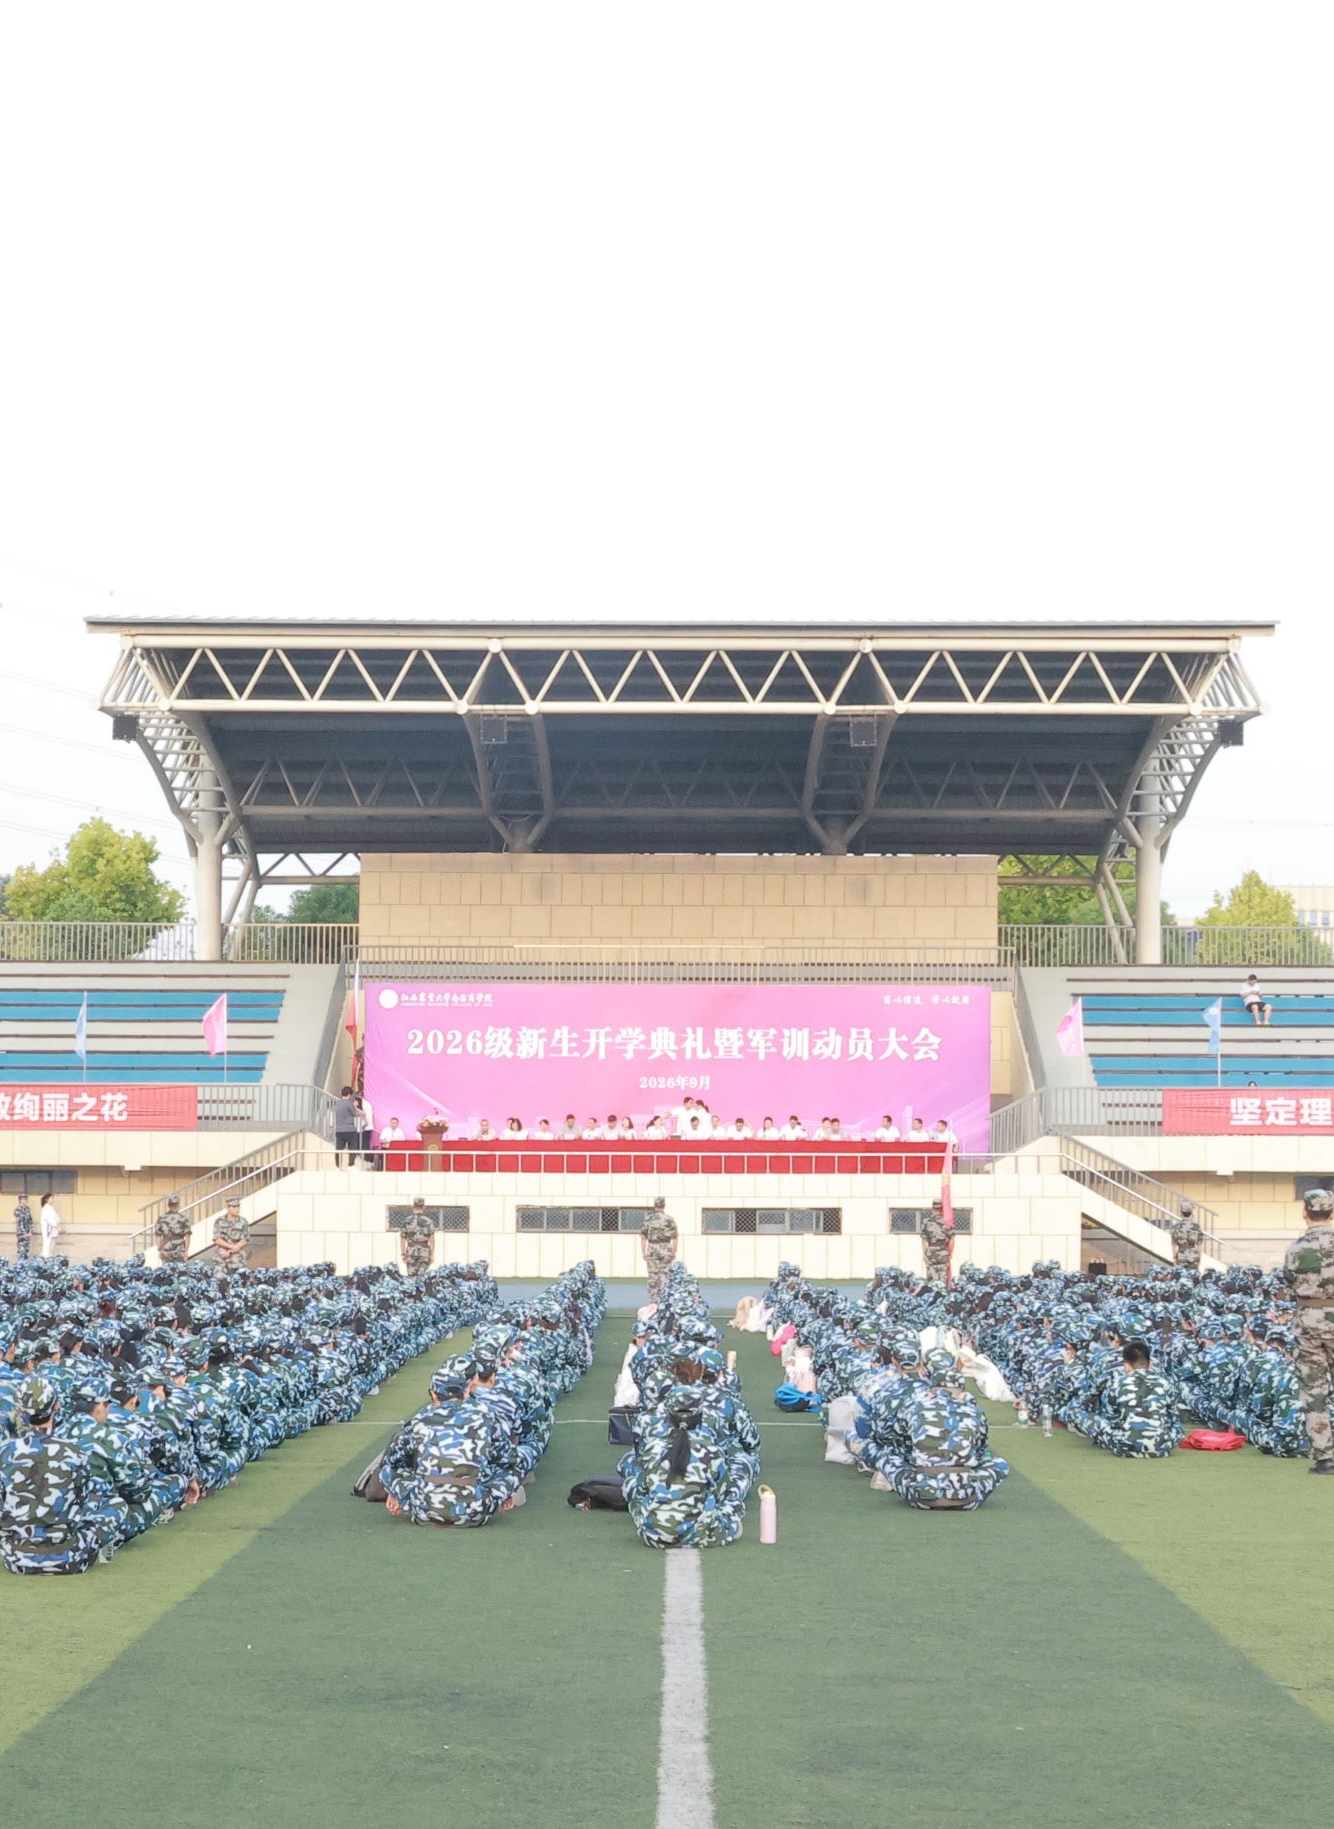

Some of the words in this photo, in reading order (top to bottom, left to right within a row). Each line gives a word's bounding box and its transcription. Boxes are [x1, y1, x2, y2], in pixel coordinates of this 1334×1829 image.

[407, 1026, 942, 1061] 2026级新生开学典礼暨军训动员大会
[639, 1075, 710, 1090] 2026年9月
